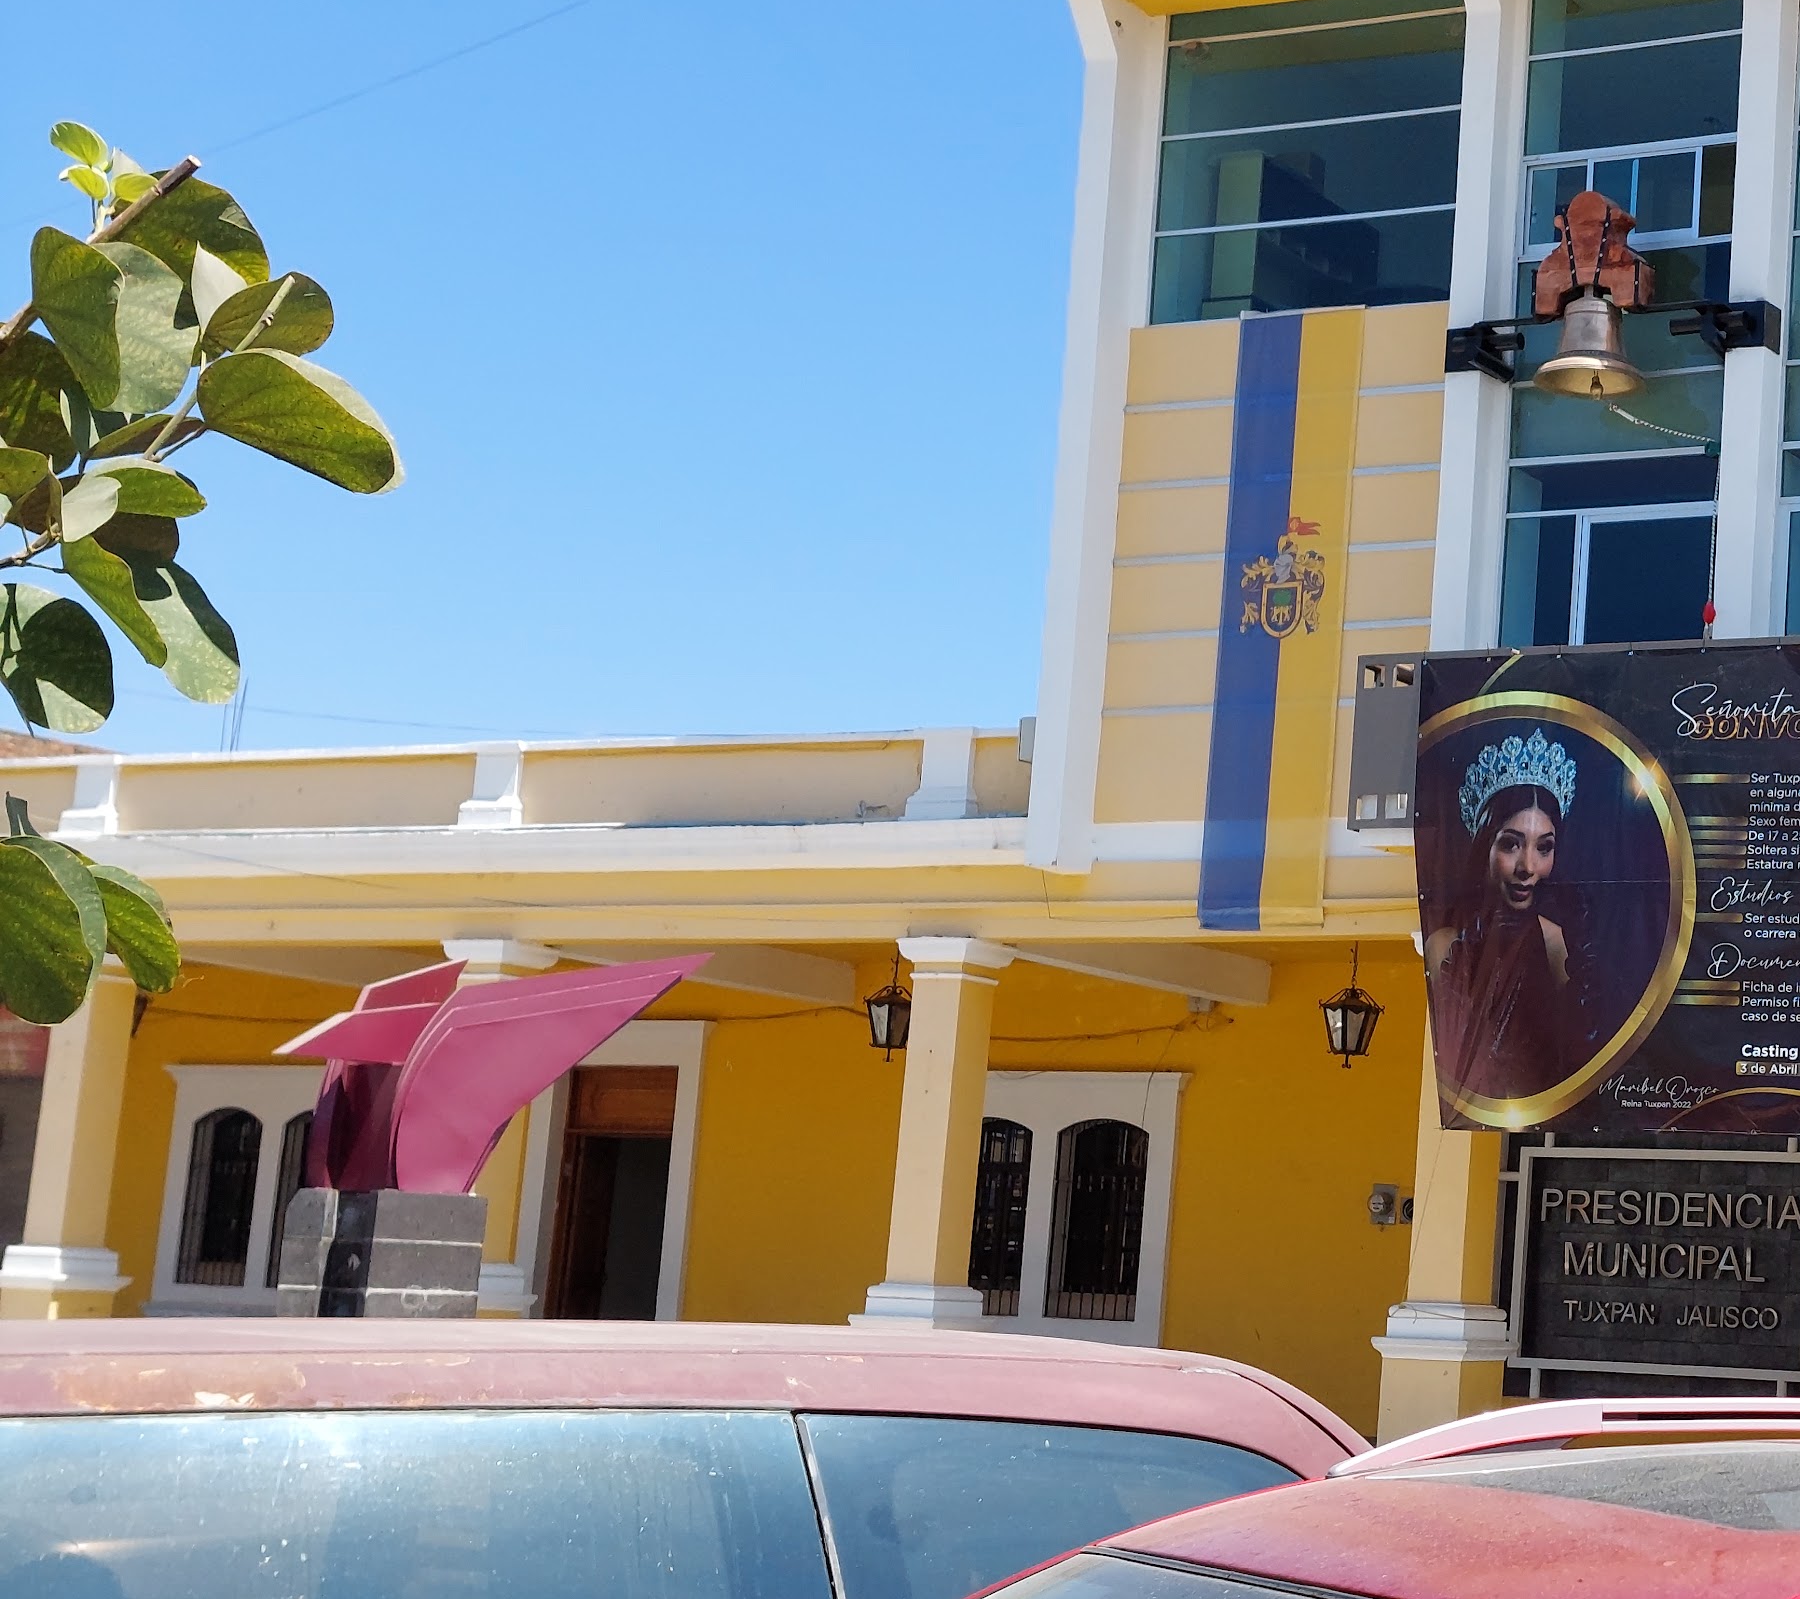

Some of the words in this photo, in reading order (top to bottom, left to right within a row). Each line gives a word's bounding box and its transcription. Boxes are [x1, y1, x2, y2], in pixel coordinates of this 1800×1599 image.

[1751, 773, 1771, 784] Ser
[1750, 789, 1764, 798] en
[1750, 802, 1790, 812] mínima
[1749, 816, 1777, 827] Sexo
[1748, 831, 1765, 841] De
[1768, 831, 1779, 842] 17
[1781, 833, 1789, 841] a
[1747, 845, 1788, 855] Soltera
[1747, 859, 1794, 870] Estatura
[1710, 876, 1794, 911] Estudios
[1744, 913, 1765, 924] Ser
[1744, 930, 1752, 938] o
[1755, 930, 1797, 939] carrera
[1742, 982, 1775, 993] Ficha
[1778, 982, 1793, 992] de
[1742, 997, 1790, 1008] Permiso
[1741, 1013, 1768, 1022] caso
[1771, 1011, 1787, 1022] de
[1741, 1044, 1799, 1060] Casting
[1740, 1064, 1747, 1073] 3
[1750, 1063, 1766, 1074] de
[1769, 1064, 1798, 1075] Abril
[1598, 1074, 1664, 1100] Maribel
[1665, 1075, 1720, 1104] Orozco
[1621, 1099, 1642, 1108] Reina
[1672, 1100, 1692, 1109] 2022
[1564, 1241, 1766, 1283] MUNICIPAL
[1563, 1299, 1655, 1325] TUXPAN
[1676, 1305, 1779, 1330] JALISCO
